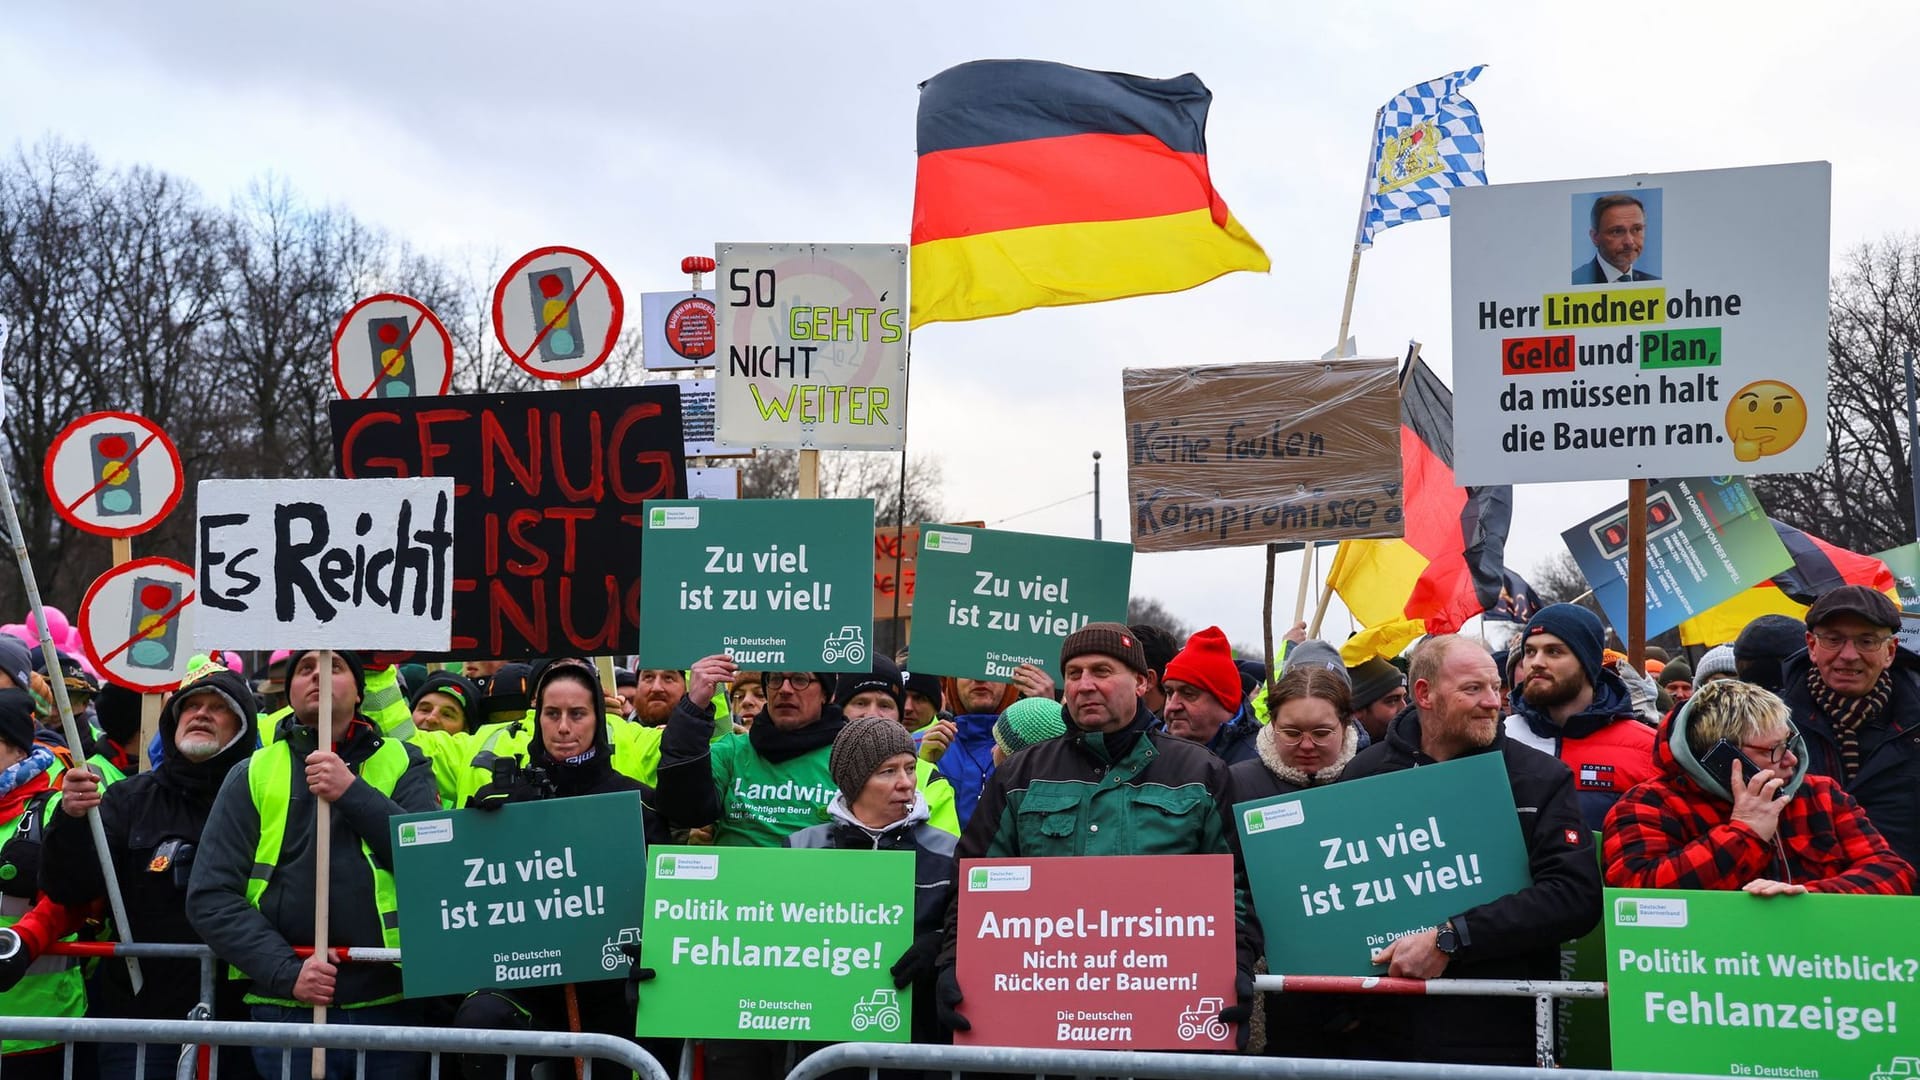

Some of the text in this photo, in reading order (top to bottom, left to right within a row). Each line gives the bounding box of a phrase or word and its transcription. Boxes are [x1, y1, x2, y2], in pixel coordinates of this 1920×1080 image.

[730, 268, 776, 308] SO
[1480, 289, 1741, 329] Herr Lindner ohne
[729, 345, 818, 379] NICHT
[1508, 333, 1716, 369] Geld und Plan,
[749, 383, 890, 426] WEITER
[1500, 373, 1718, 411] da müssen halt
[342, 402, 675, 504] GENUG
[1133, 419, 1325, 465] Keine faulen
[1503, 423, 1722, 452] die Bauern ran.
[1678, 480, 1691, 497] WIR
[1686, 495, 1710, 530] FORDERN
[1705, 528, 1719, 545] VON
[1714, 543, 1727, 560] DER
[200, 489, 453, 622] Es Reicht
[485, 508, 597, 577] IST
[705, 545, 808, 573] Zu viel
[681, 582, 831, 610] ist zu viel!
[974, 571, 1068, 603] Zu viel
[949, 600, 980, 627] ist
[988, 611, 1019, 631] zu
[723, 636, 786, 646] Die Deutschen
[724, 647, 785, 664] Bauern
[986, 651, 1002, 661] Die
[985, 661, 1013, 676] Bau
[787, 807, 811, 815] Beruf
[1320, 817, 1445, 869] Zu viel
[464, 847, 576, 887] Zu viel
[1300, 854, 1482, 916] ist zu viel!
[441, 886, 604, 929] ist zu viel!
[655, 899, 903, 924] Politik mit Weitblick?
[977, 908, 1214, 945] Ampel-Irrsinn:
[1366, 934, 1385, 946] Die
[494, 949, 561, 962] Die Deutschen
[672, 936, 881, 976] Fehlanzeige!
[1024, 950, 1167, 968] Nicht auf dem
[1619, 949, 1918, 982] Politik mit Weitblick?
[496, 963, 562, 981] Bauern
[995, 973, 1197, 991] Rücken der Bauern!
[739, 999, 812, 1009] Die Deutschen
[1057, 1011, 1132, 1020] Die Deutschen
[1645, 992, 1896, 1040] Fehlanzeige!
[739, 1011, 810, 1030] Bauern
[1057, 1023, 1131, 1041] Bauern
[1730, 1064, 1819, 1079] Die Deutschen
